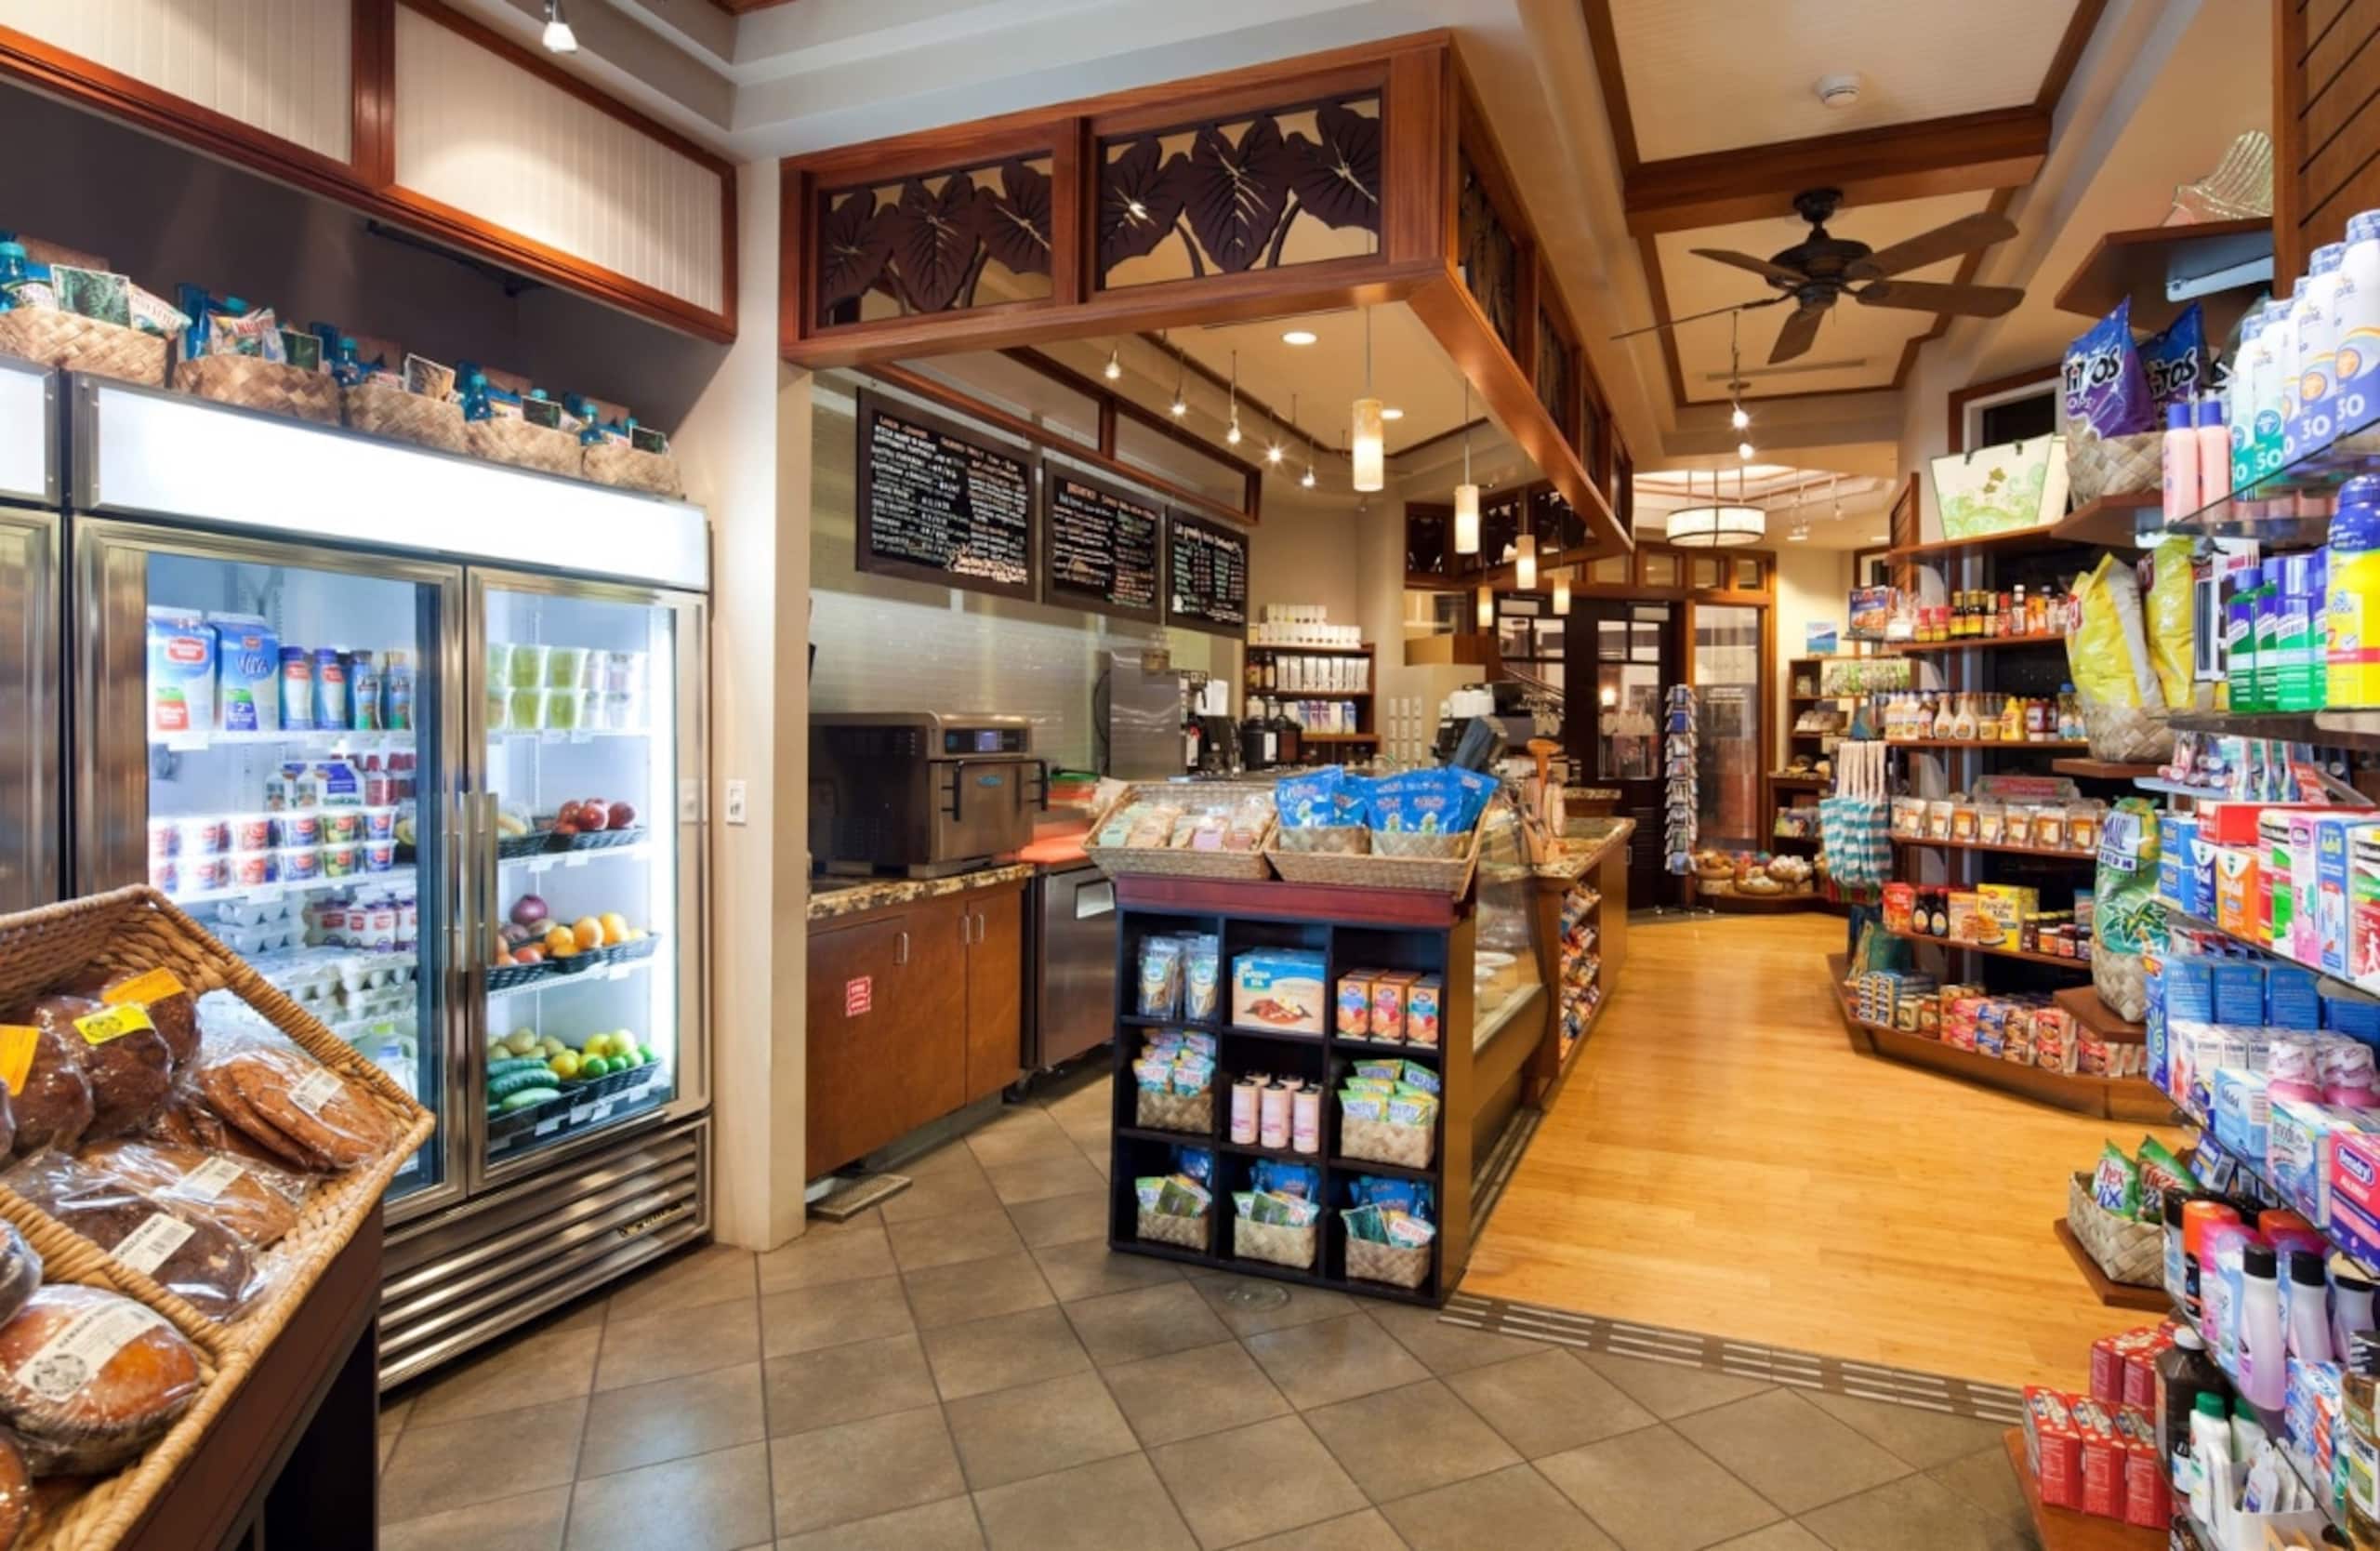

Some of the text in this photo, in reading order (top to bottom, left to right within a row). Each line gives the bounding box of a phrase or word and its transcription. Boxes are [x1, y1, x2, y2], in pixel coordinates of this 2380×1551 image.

[2335, 392, 2365, 421] 30
[2301, 415, 2332, 441] 30
[2282, 434, 2295, 456] 0
[2255, 448, 2283, 471] 50
